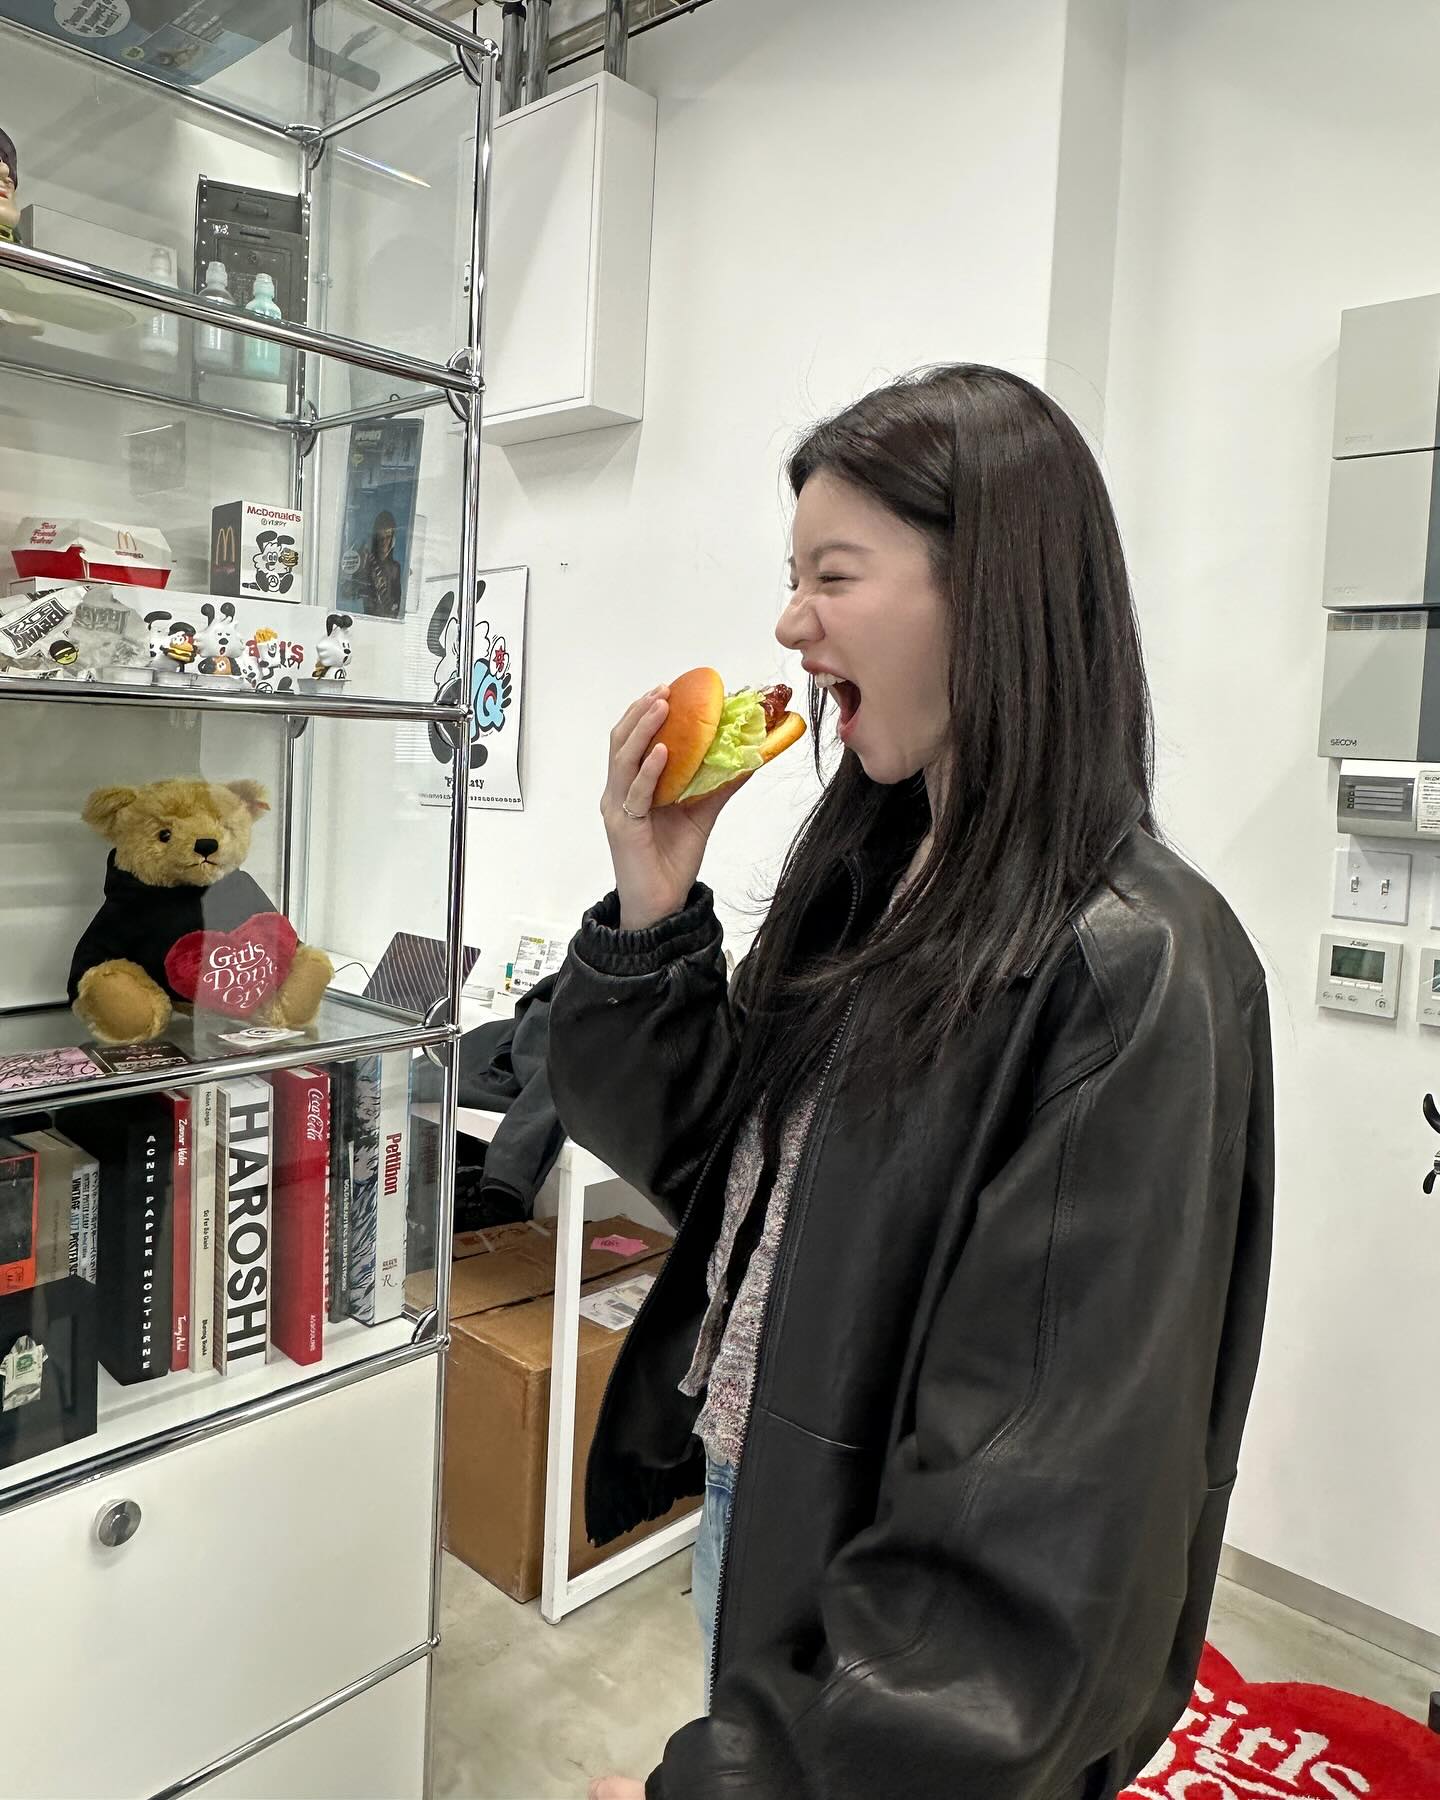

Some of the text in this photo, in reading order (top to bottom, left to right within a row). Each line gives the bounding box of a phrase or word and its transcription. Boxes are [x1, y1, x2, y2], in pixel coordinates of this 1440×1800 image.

[247, 505, 301, 522] McDonald's
[209, 941, 265, 971] Girls
[203, 957, 278, 990] Don't
[223, 980, 269, 1008] Cry
[384, 1132, 402, 1196] Pettibon
[227, 1102, 269, 1362] HAROSHI
[142, 1135, 156, 1369] ACNE PAPER NOCTURNE
